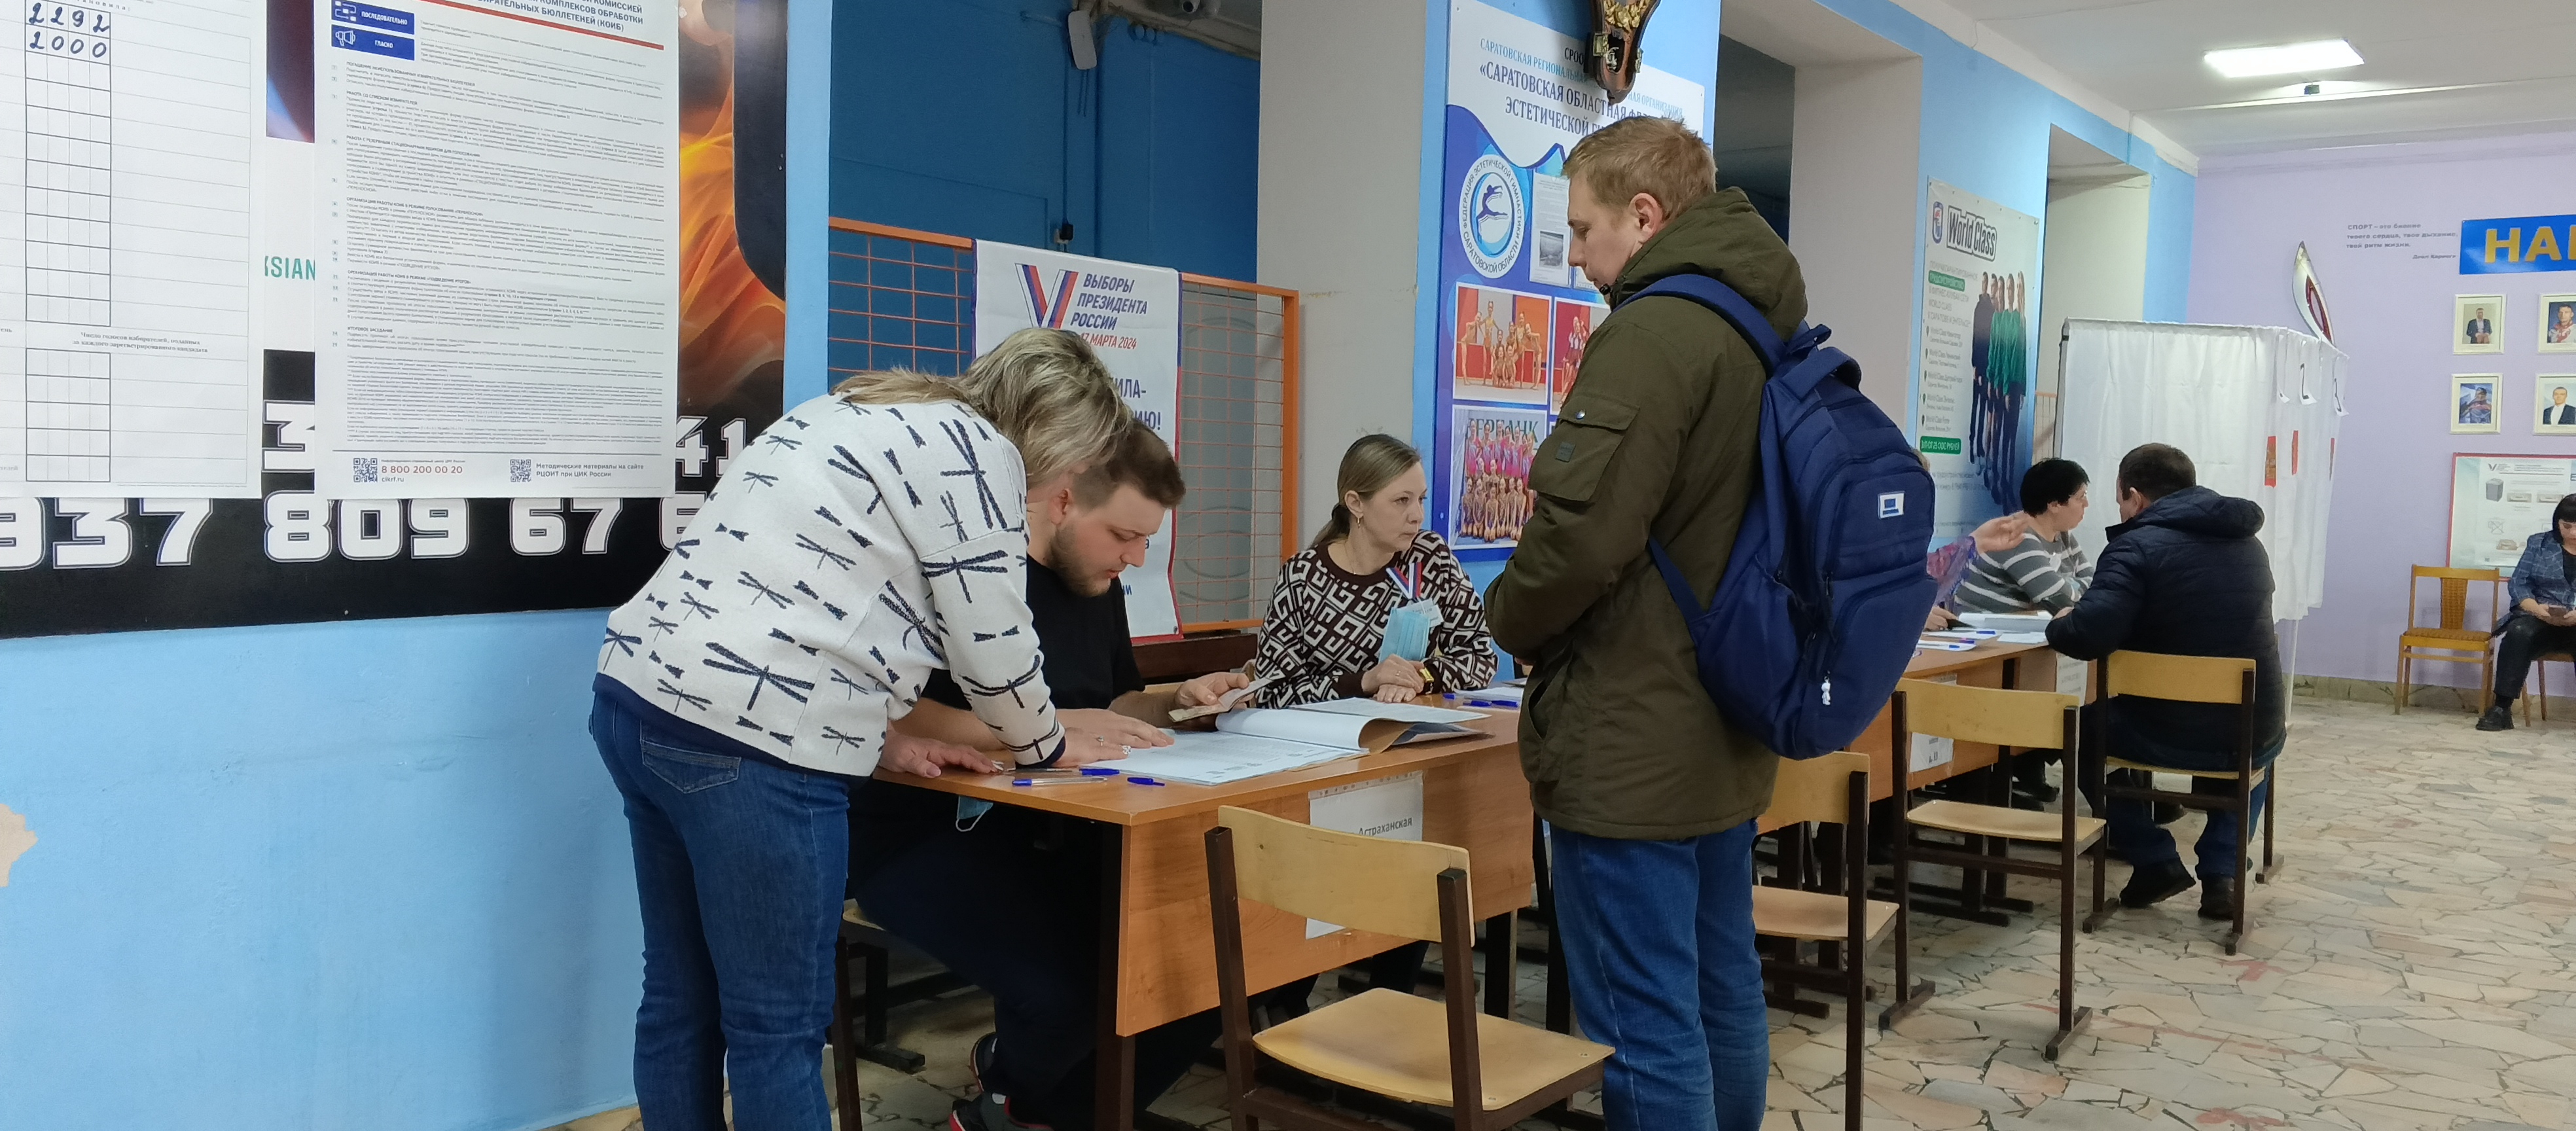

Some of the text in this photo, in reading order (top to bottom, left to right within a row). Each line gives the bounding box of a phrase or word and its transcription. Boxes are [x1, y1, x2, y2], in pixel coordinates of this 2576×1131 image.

[361, 11, 408, 25] ПОСЛЕДОВАТЕЛЬНО
[478, 0, 624, 32] РАТЕЛЬНЫХ БЮЛЛЕТЕНЕЙ (КОИБ)
[598, 9, 643, 24] ОБРАБОТКИ
[374, 40, 394, 48] ГЛАСНО
[1480, 38, 1531, 66] САРАТОВСКАЯ
[1480, 61, 1626, 120] «САРАТОВСКАЯ ОБЛАСТНАЯ
[1505, 96, 1588, 136] ЭСТЕТИЧЕСКОЙ
[1462, 174, 1475, 229] ФЕДЕРАЦИЯ
[1509, 177, 1522, 240] ГИМНАСТИКИ
[1949, 211, 1995, 256] World Class
[2484, 225, 2576, 264] НА
[1463, 231, 1498, 274] САРАТОВСКОЙ
[1498, 241, 1519, 272] ОБЛАСТИ
[1083, 273, 1135, 293] ВЫБОРЫ
[1077, 293, 1148, 314] ПРЕЗИДЕНТА
[1070, 312, 1118, 331] РОССИИ
[1090, 333, 1118, 348] МАРТА
[1118, 336, 1137, 350] 2024
[1110, 378, 1146, 398] ИЛА-
[390, 465, 410, 474] 800
[413, 465, 432, 474] 200
[435, 465, 448, 474] 00
[451, 465, 463, 474] 20
[263, 490, 470, 564] 809
[509, 497, 624, 555] 67
[1359, 817, 1412, 836] Астраханская
